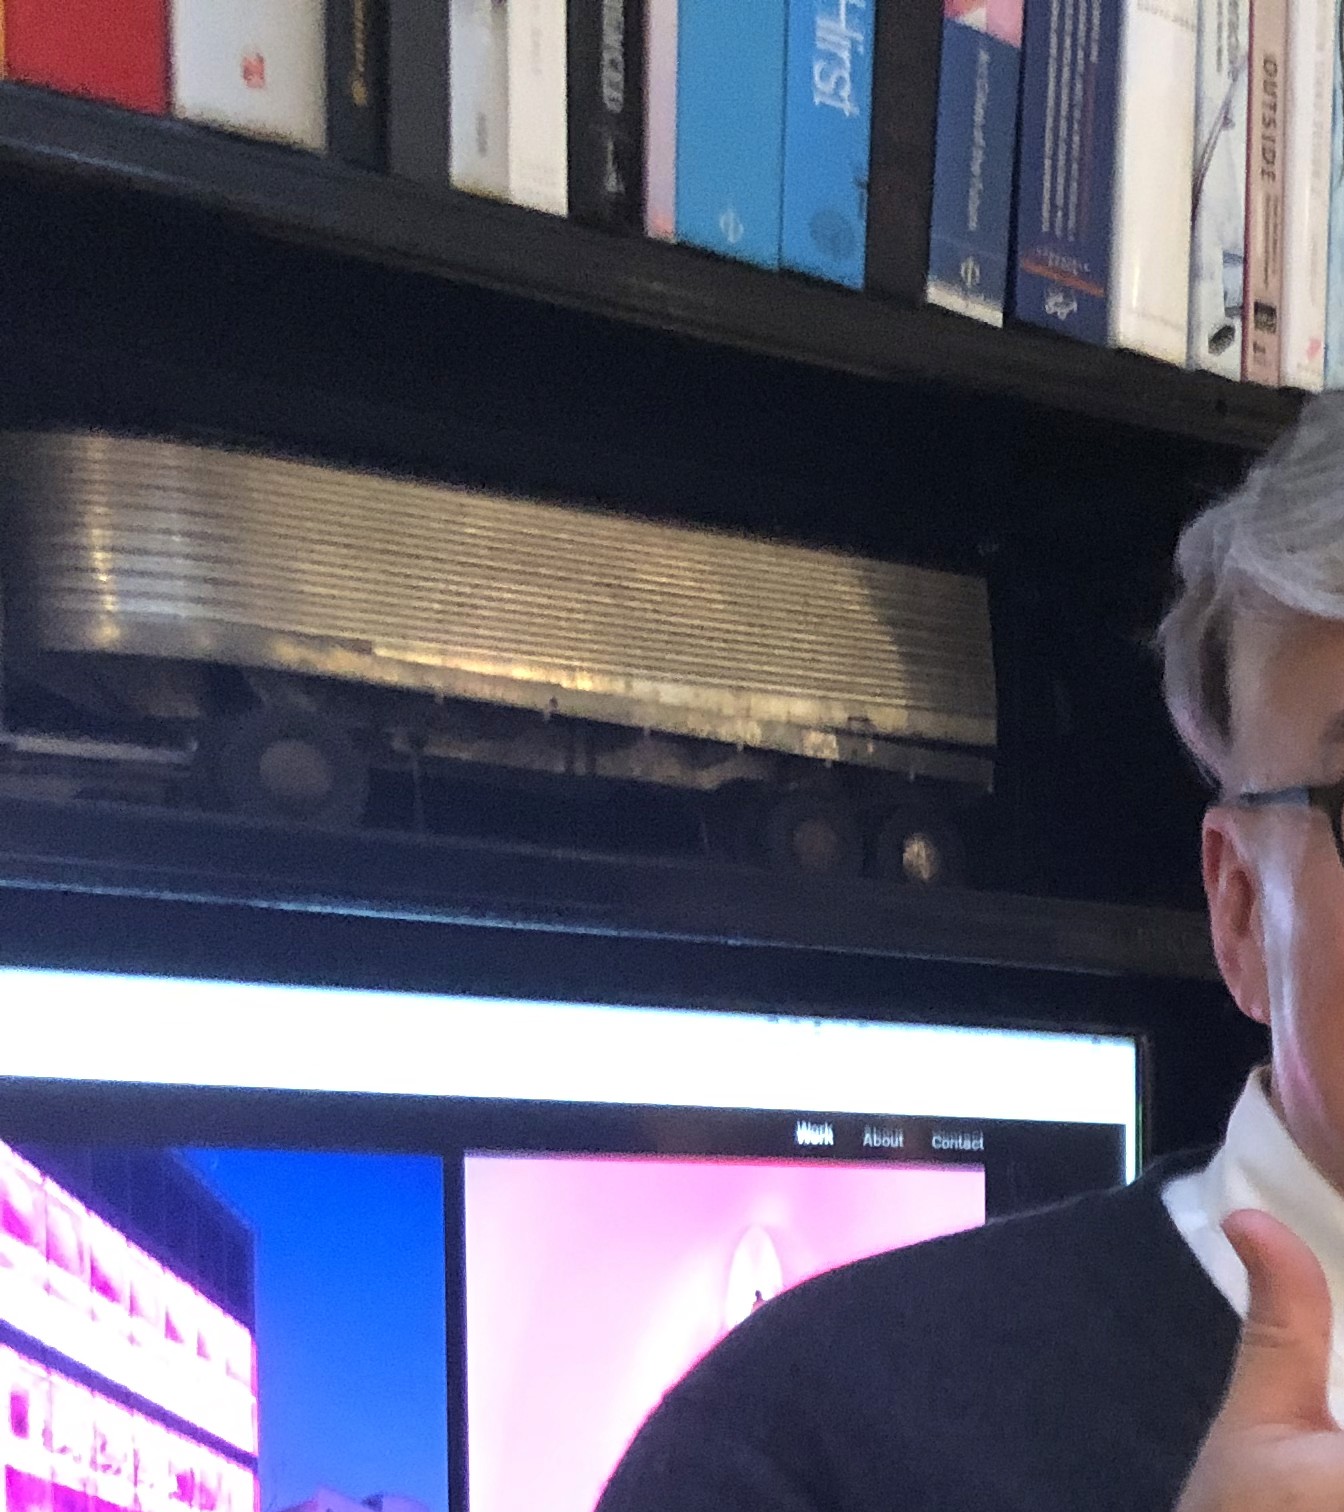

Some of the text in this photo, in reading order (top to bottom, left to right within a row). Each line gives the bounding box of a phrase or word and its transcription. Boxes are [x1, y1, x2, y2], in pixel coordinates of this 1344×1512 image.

[1261, 56, 1279, 182] OUTSIDE
[796, 1121, 984, 1151] Work About Contact
